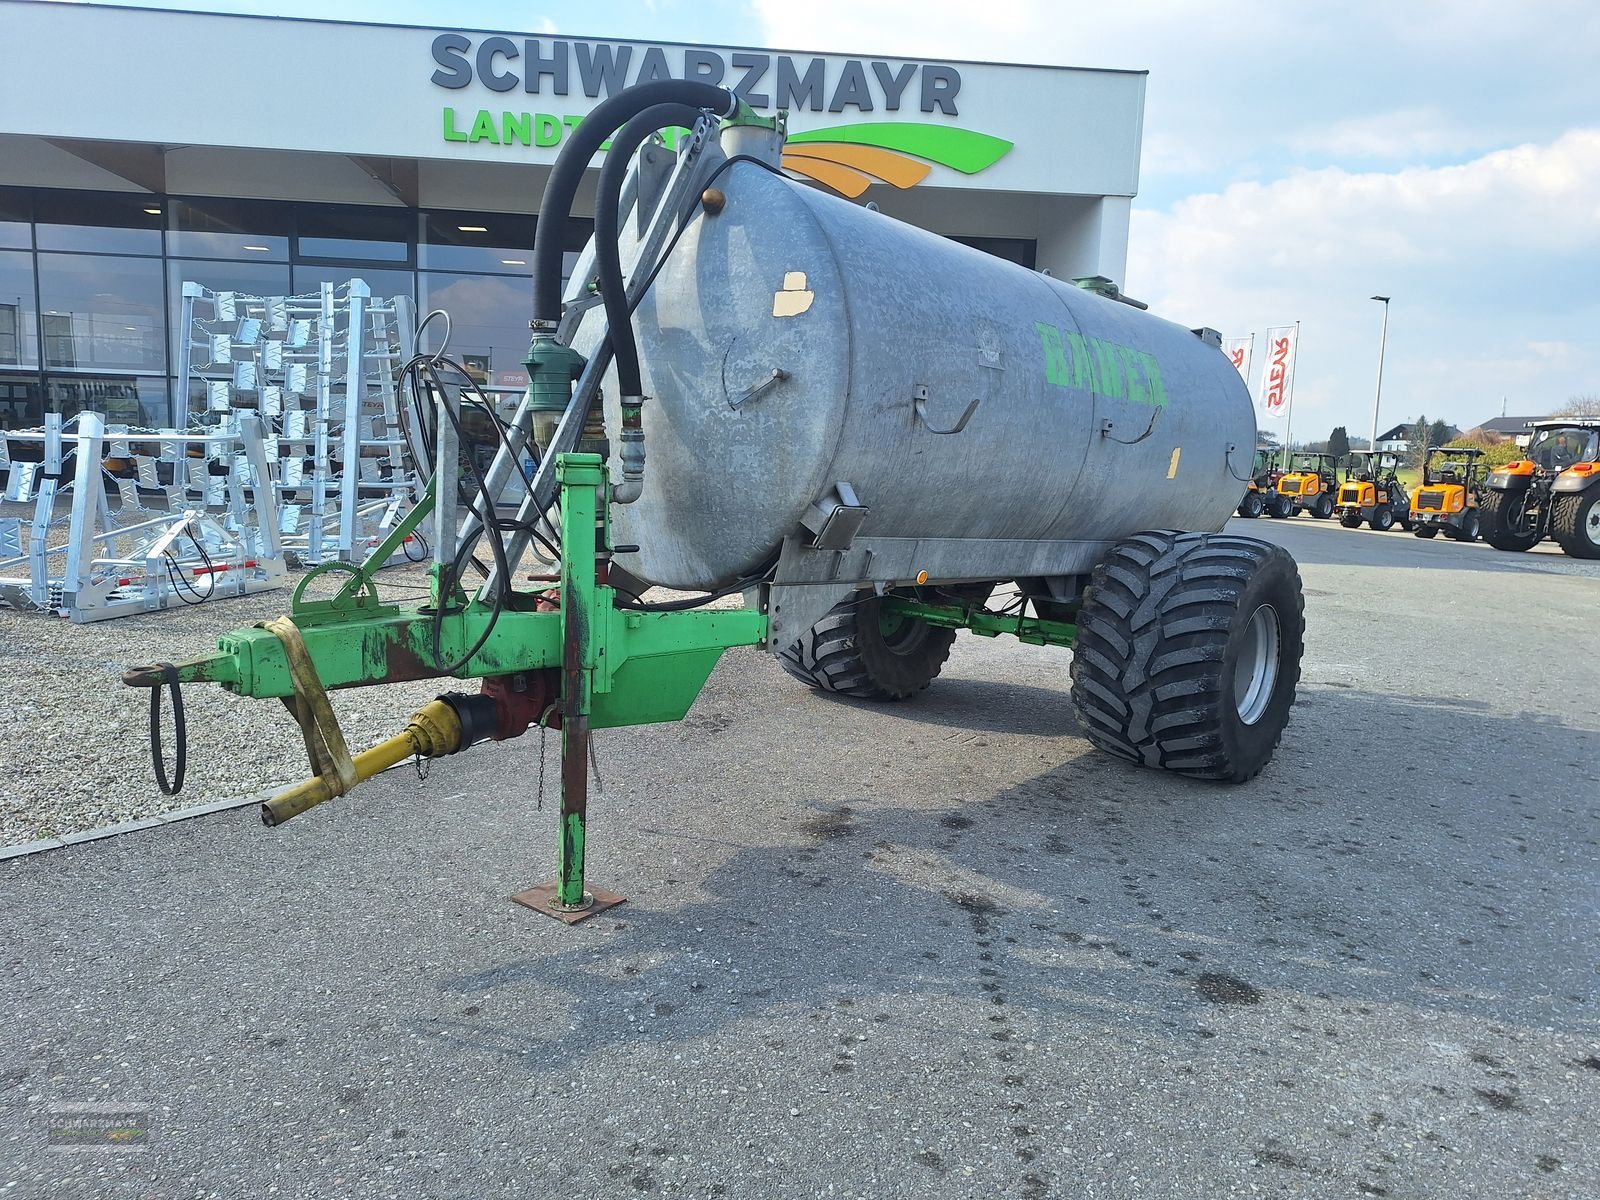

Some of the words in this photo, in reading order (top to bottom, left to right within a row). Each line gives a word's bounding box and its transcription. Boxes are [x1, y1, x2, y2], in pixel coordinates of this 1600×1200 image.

[430, 33, 962, 115] SCHWARZMAYR
[503, 375, 524, 383] STEYR
[1033, 320, 1169, 408] BAUER
